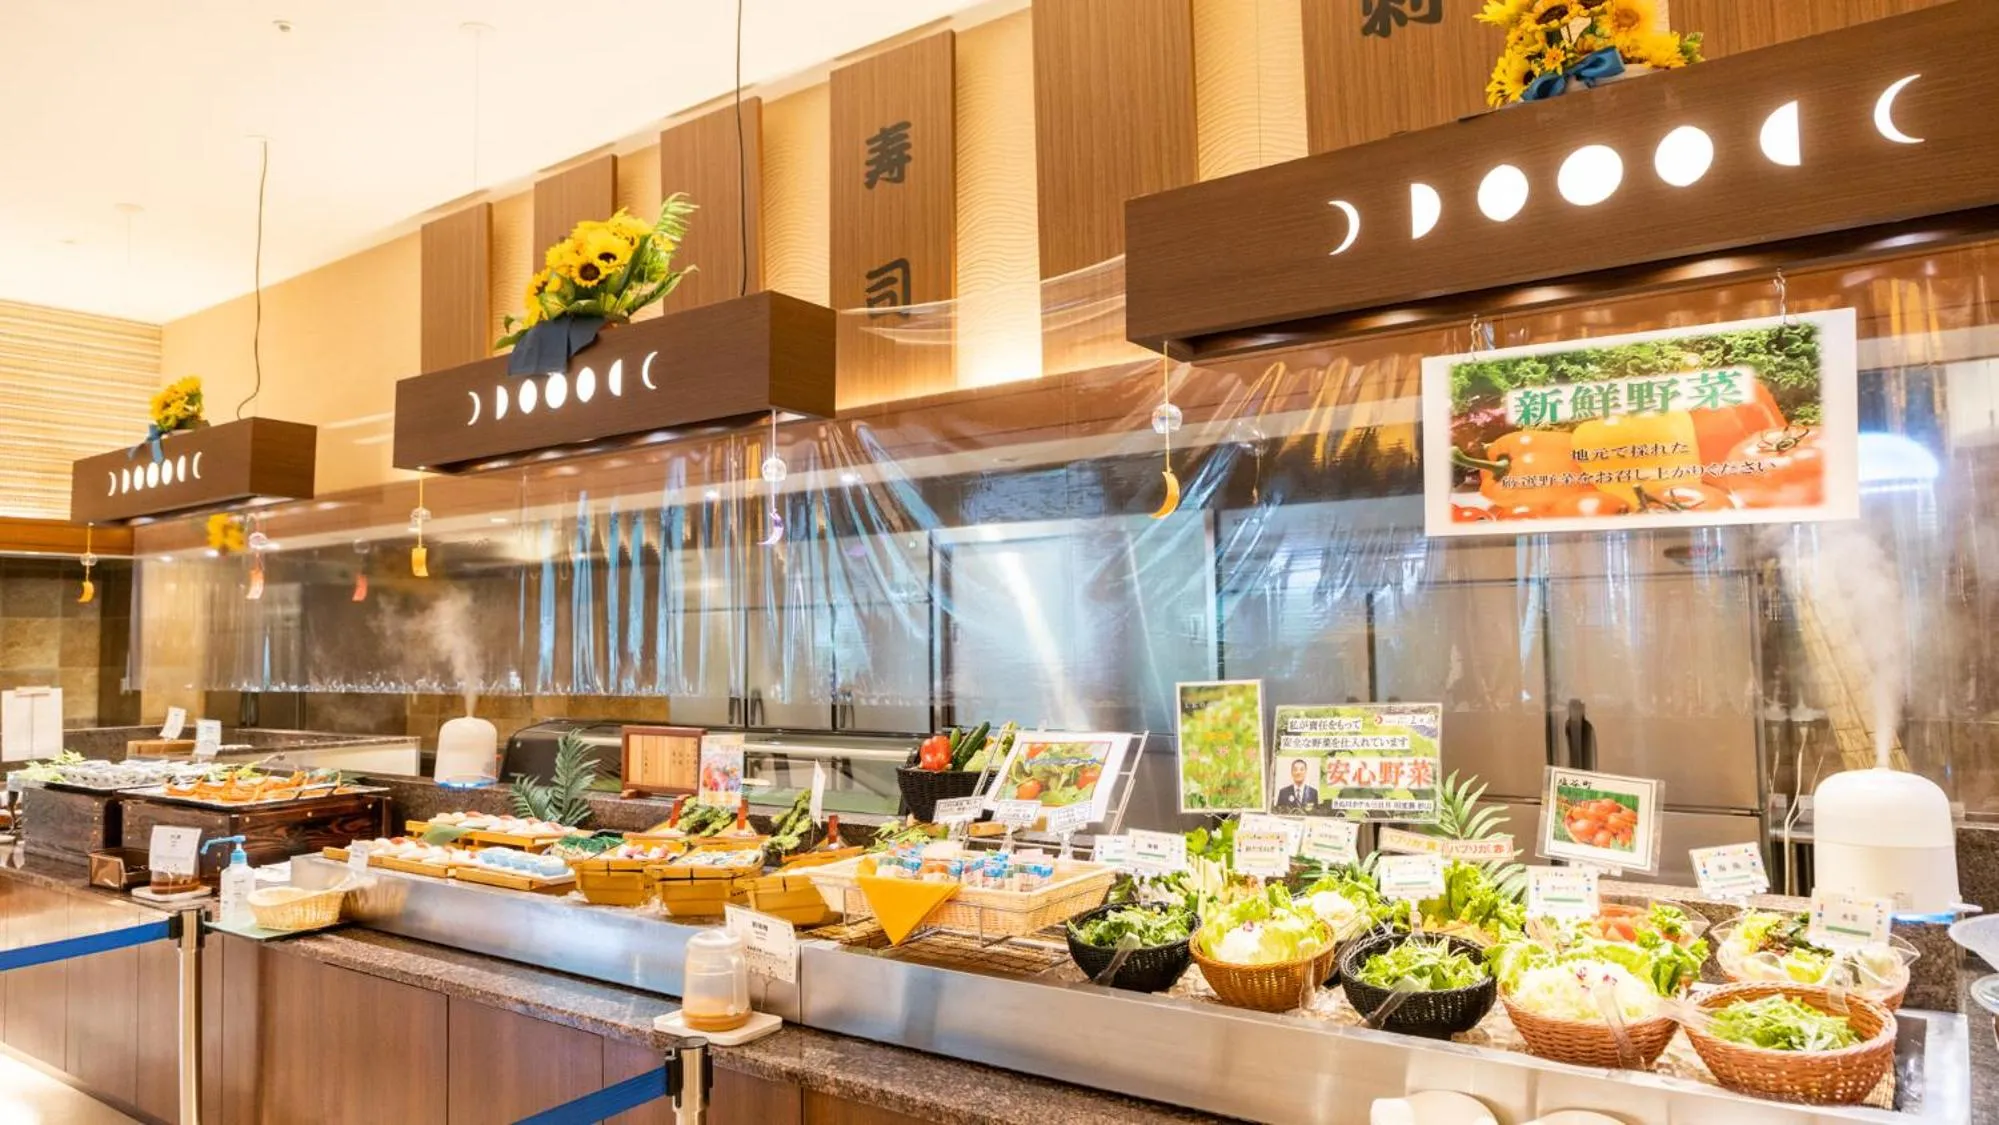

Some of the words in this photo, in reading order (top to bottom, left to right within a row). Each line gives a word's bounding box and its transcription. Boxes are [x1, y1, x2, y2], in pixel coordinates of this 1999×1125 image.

[864, 120, 912, 319] 寿司
[1515, 370, 1744, 426] 新鮮野菜
[1571, 441, 1690, 462] 地元で採れた
[1502, 460, 1778, 489] 厳選野菜をお召し上がりください
[1289, 718, 1361, 731] 私が責任をもって
[1282, 736, 1409, 748] 安全な野菜を仕入れています
[1327, 758, 1433, 786] 安心野菜
